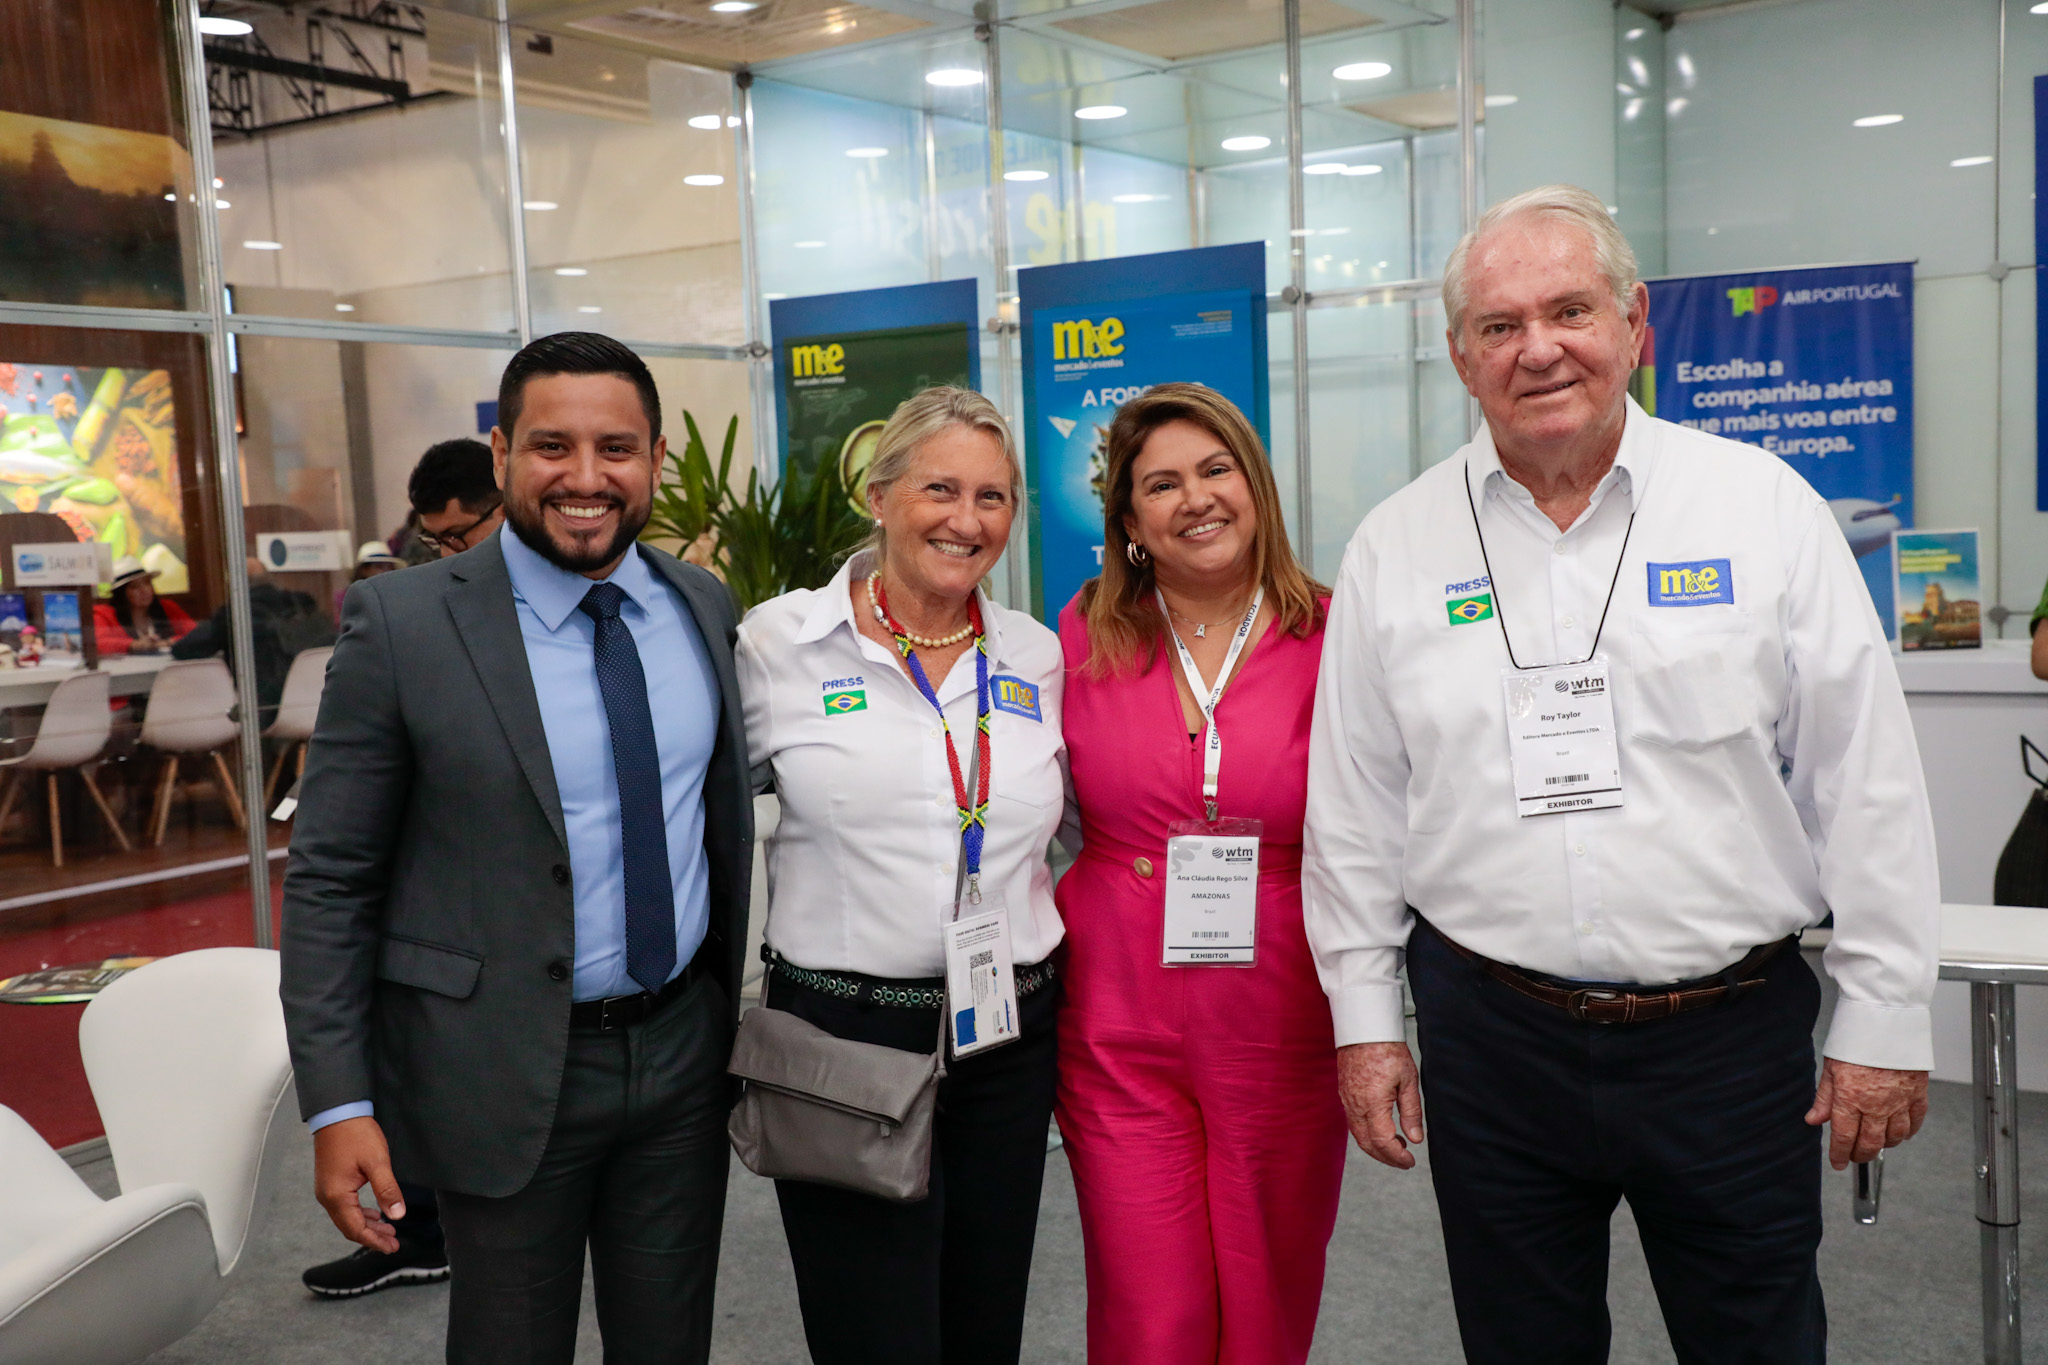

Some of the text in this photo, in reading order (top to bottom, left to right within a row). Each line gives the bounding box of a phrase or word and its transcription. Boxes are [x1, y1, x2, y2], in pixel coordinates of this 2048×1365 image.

[1052, 317, 1125, 360] m&e
[1677, 358, 1783, 383] Escolha a
[1081, 389, 1098, 408] A
[1693, 376, 1893, 410] companhia aérea
[1723, 409, 1780, 433] mais
[1782, 409, 1827, 428] voa
[1829, 404, 1897, 426] entre
[1762, 435, 1855, 458] Europa.
[1445, 575, 1490, 595] PRESS
[1660, 566, 1719, 593] m&e
[822, 676, 864, 691] PRESS
[1571, 676, 1604, 689] wtm
[1540, 711, 1581, 722] Roy Taylor
[1547, 798, 1594, 809] EXHIBITOR
[1225, 846, 1253, 857] wtm
[1216, 875, 1233, 883] Rego
[1191, 892, 1231, 900] AMAZONAS
